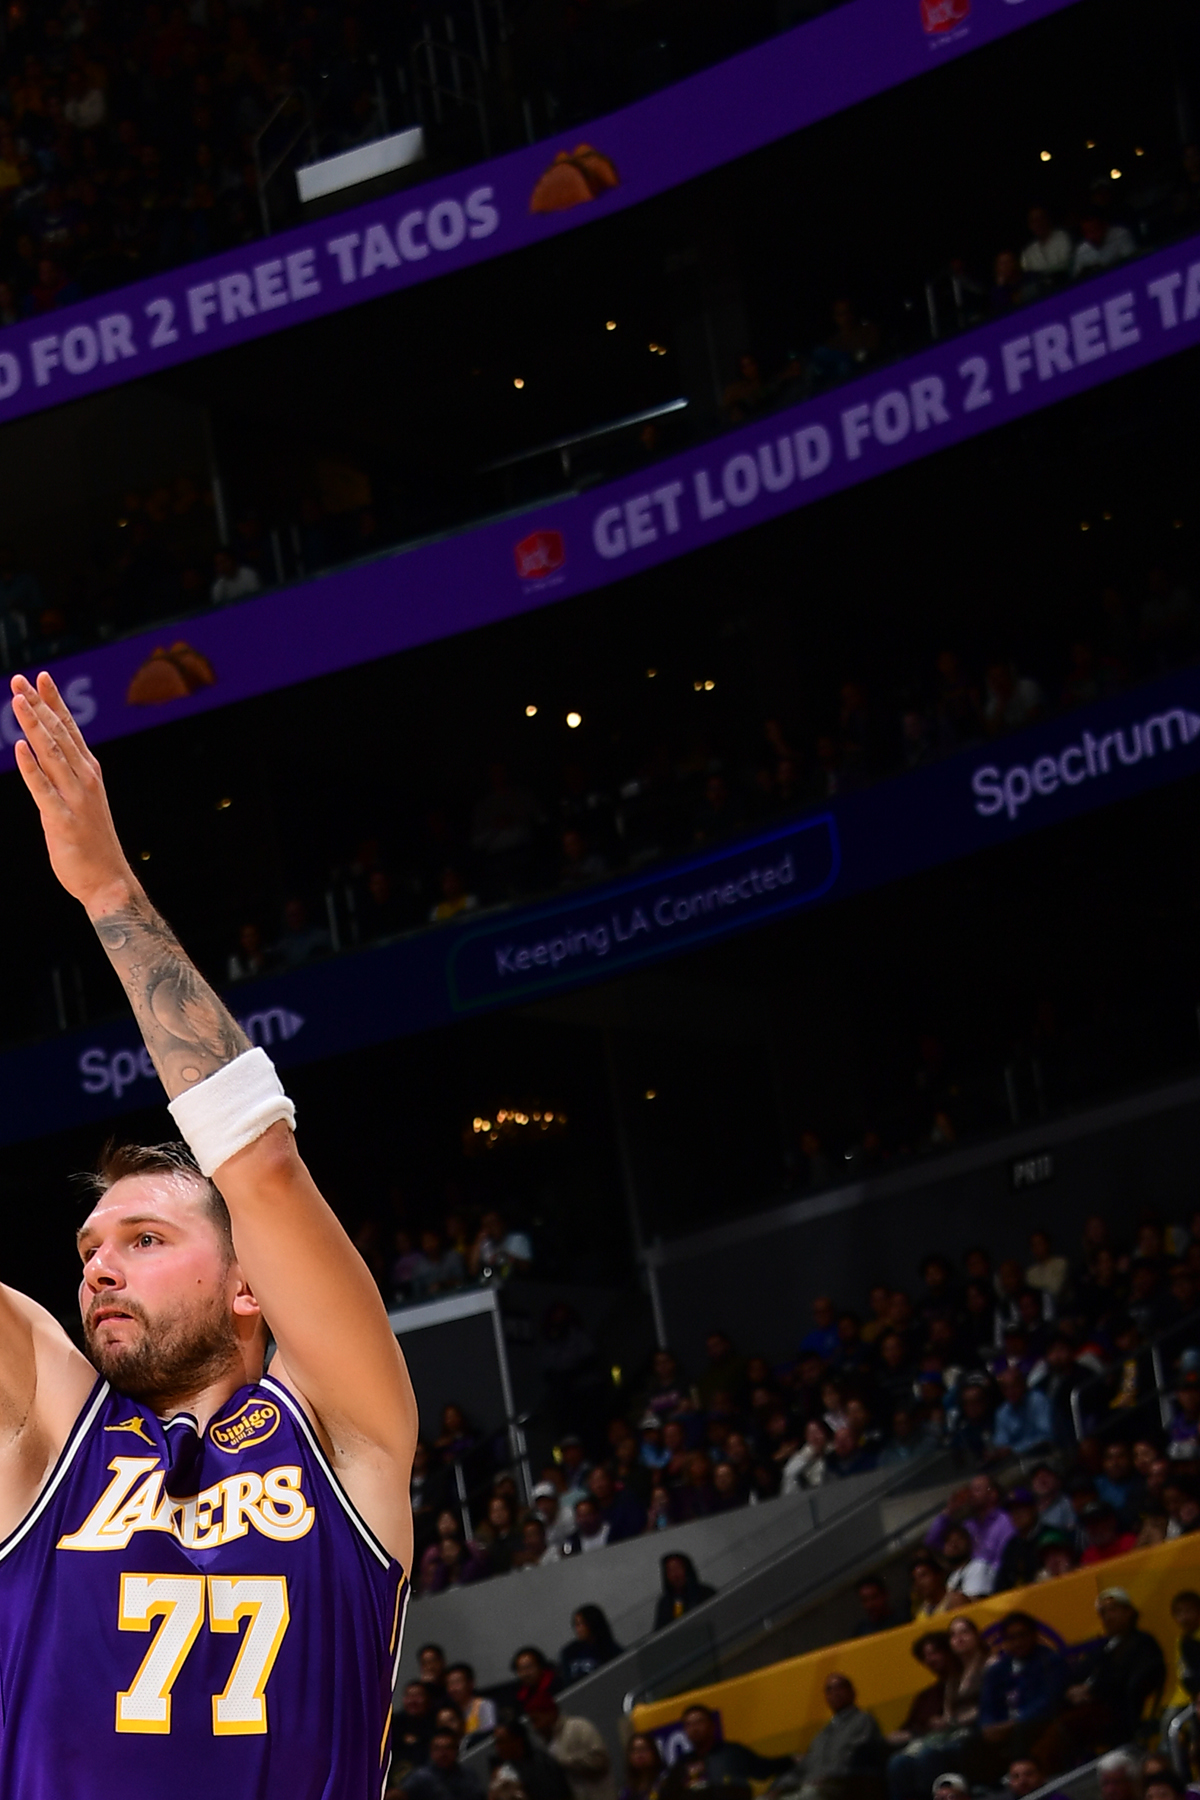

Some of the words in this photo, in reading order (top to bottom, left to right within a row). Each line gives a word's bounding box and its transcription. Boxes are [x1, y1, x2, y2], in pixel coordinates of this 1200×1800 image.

[29, 312, 138, 388] FOR
[144, 296, 179, 350] 2
[186, 247, 322, 336] FREE
[326, 185, 500, 286] TACOS
[592, 479, 685, 561] GET
[693, 422, 834, 523] LOUD
[840, 374, 953, 462] FOR
[957, 353, 995, 414] 2
[1000, 290, 1142, 396] FREE
[971, 707, 1194, 821] Spectrum
[495, 922, 611, 977] Keeping
[611, 905, 650, 942] LA
[653, 852, 796, 927] Connected
[215, 1407, 275, 1442] bibigo
[115, 1572, 290, 1736] 77
